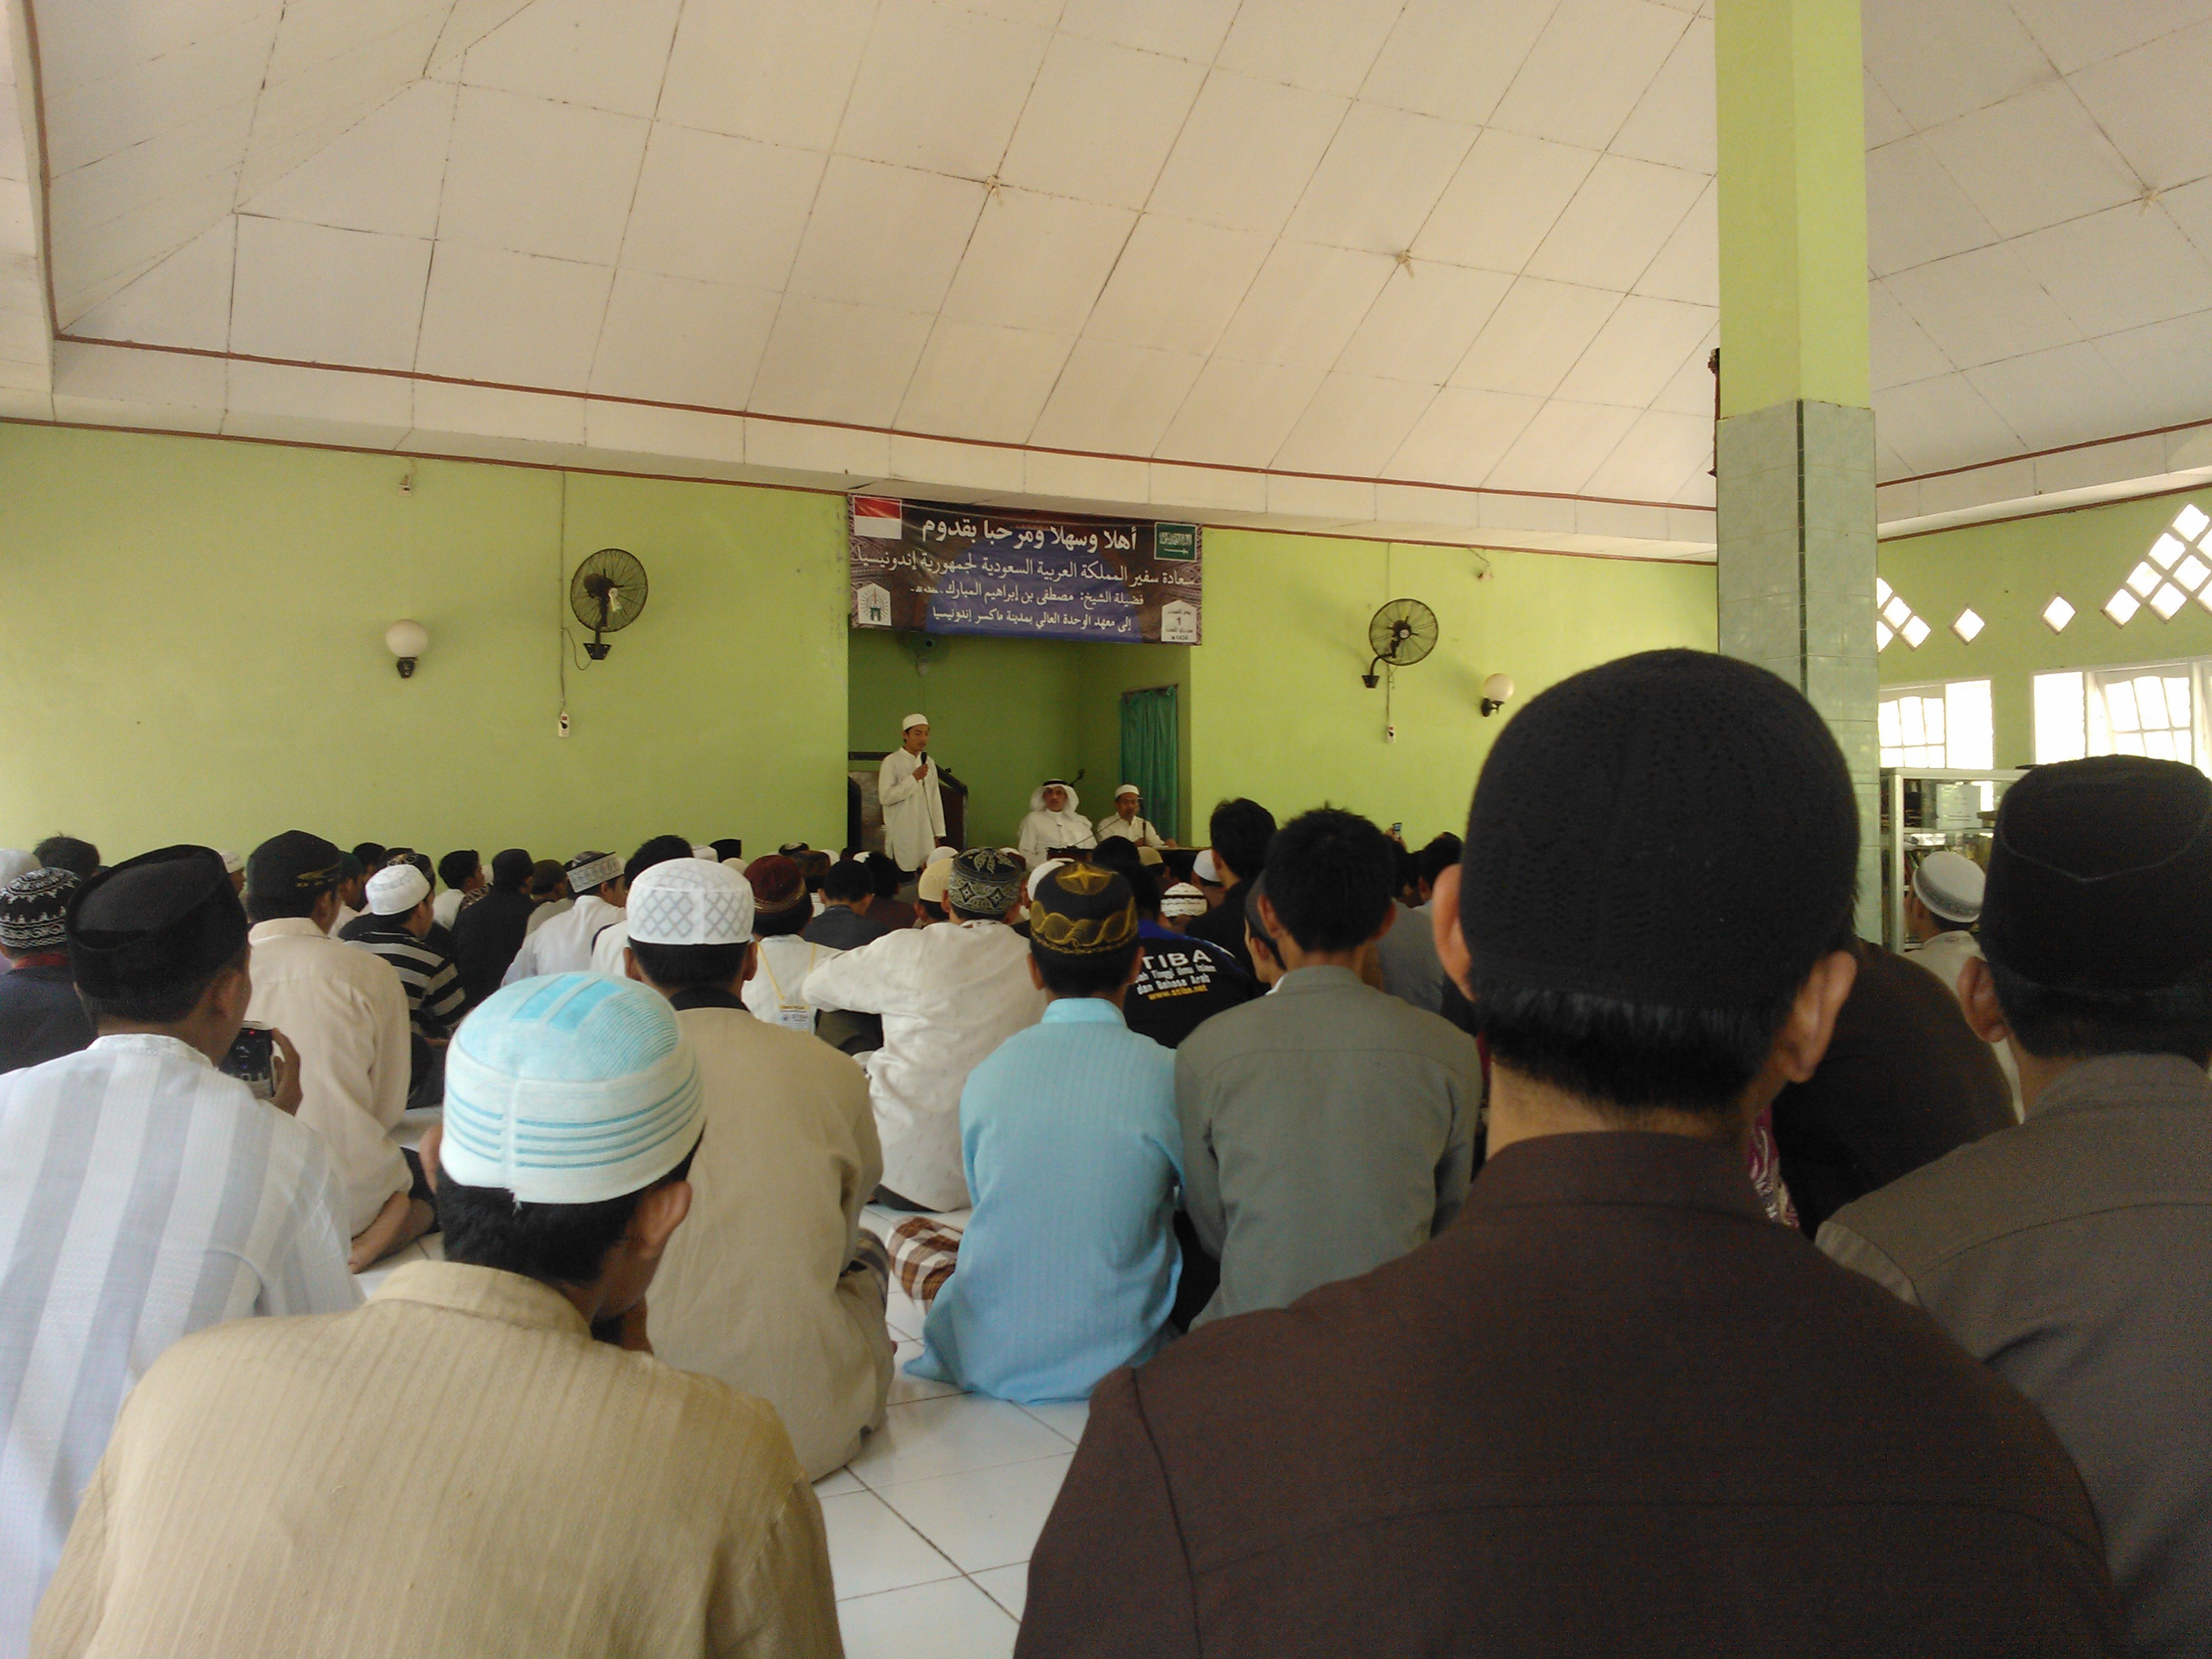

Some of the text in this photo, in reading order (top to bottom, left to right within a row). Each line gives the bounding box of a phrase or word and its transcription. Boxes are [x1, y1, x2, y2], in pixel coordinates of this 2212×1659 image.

[922, 518, 977, 543] بقدوم
[1051, 526, 1098, 553] وسهلا
[1103, 526, 1137, 550] أهلا
[920, 552, 977, 574] لجمهورية
[981, 557, 1033, 579] السعودية
[1038, 561, 1077, 582] العربية
[1082, 560, 1127, 581] المملكة
[1130, 570, 1158, 587] سفير
[945, 580, 981, 599] المبارك
[984, 585, 1019, 604] إبراهيم
[1021, 592, 1033, 604] بن
[1036, 588, 1073, 605] مصطفى
[1114, 592, 1144, 605] فضيلة
[1063, 614, 1090, 630] الوحدة
[1094, 615, 1115, 630] معهد
[1136, 972, 1211, 995] dan Bahasa Arab
